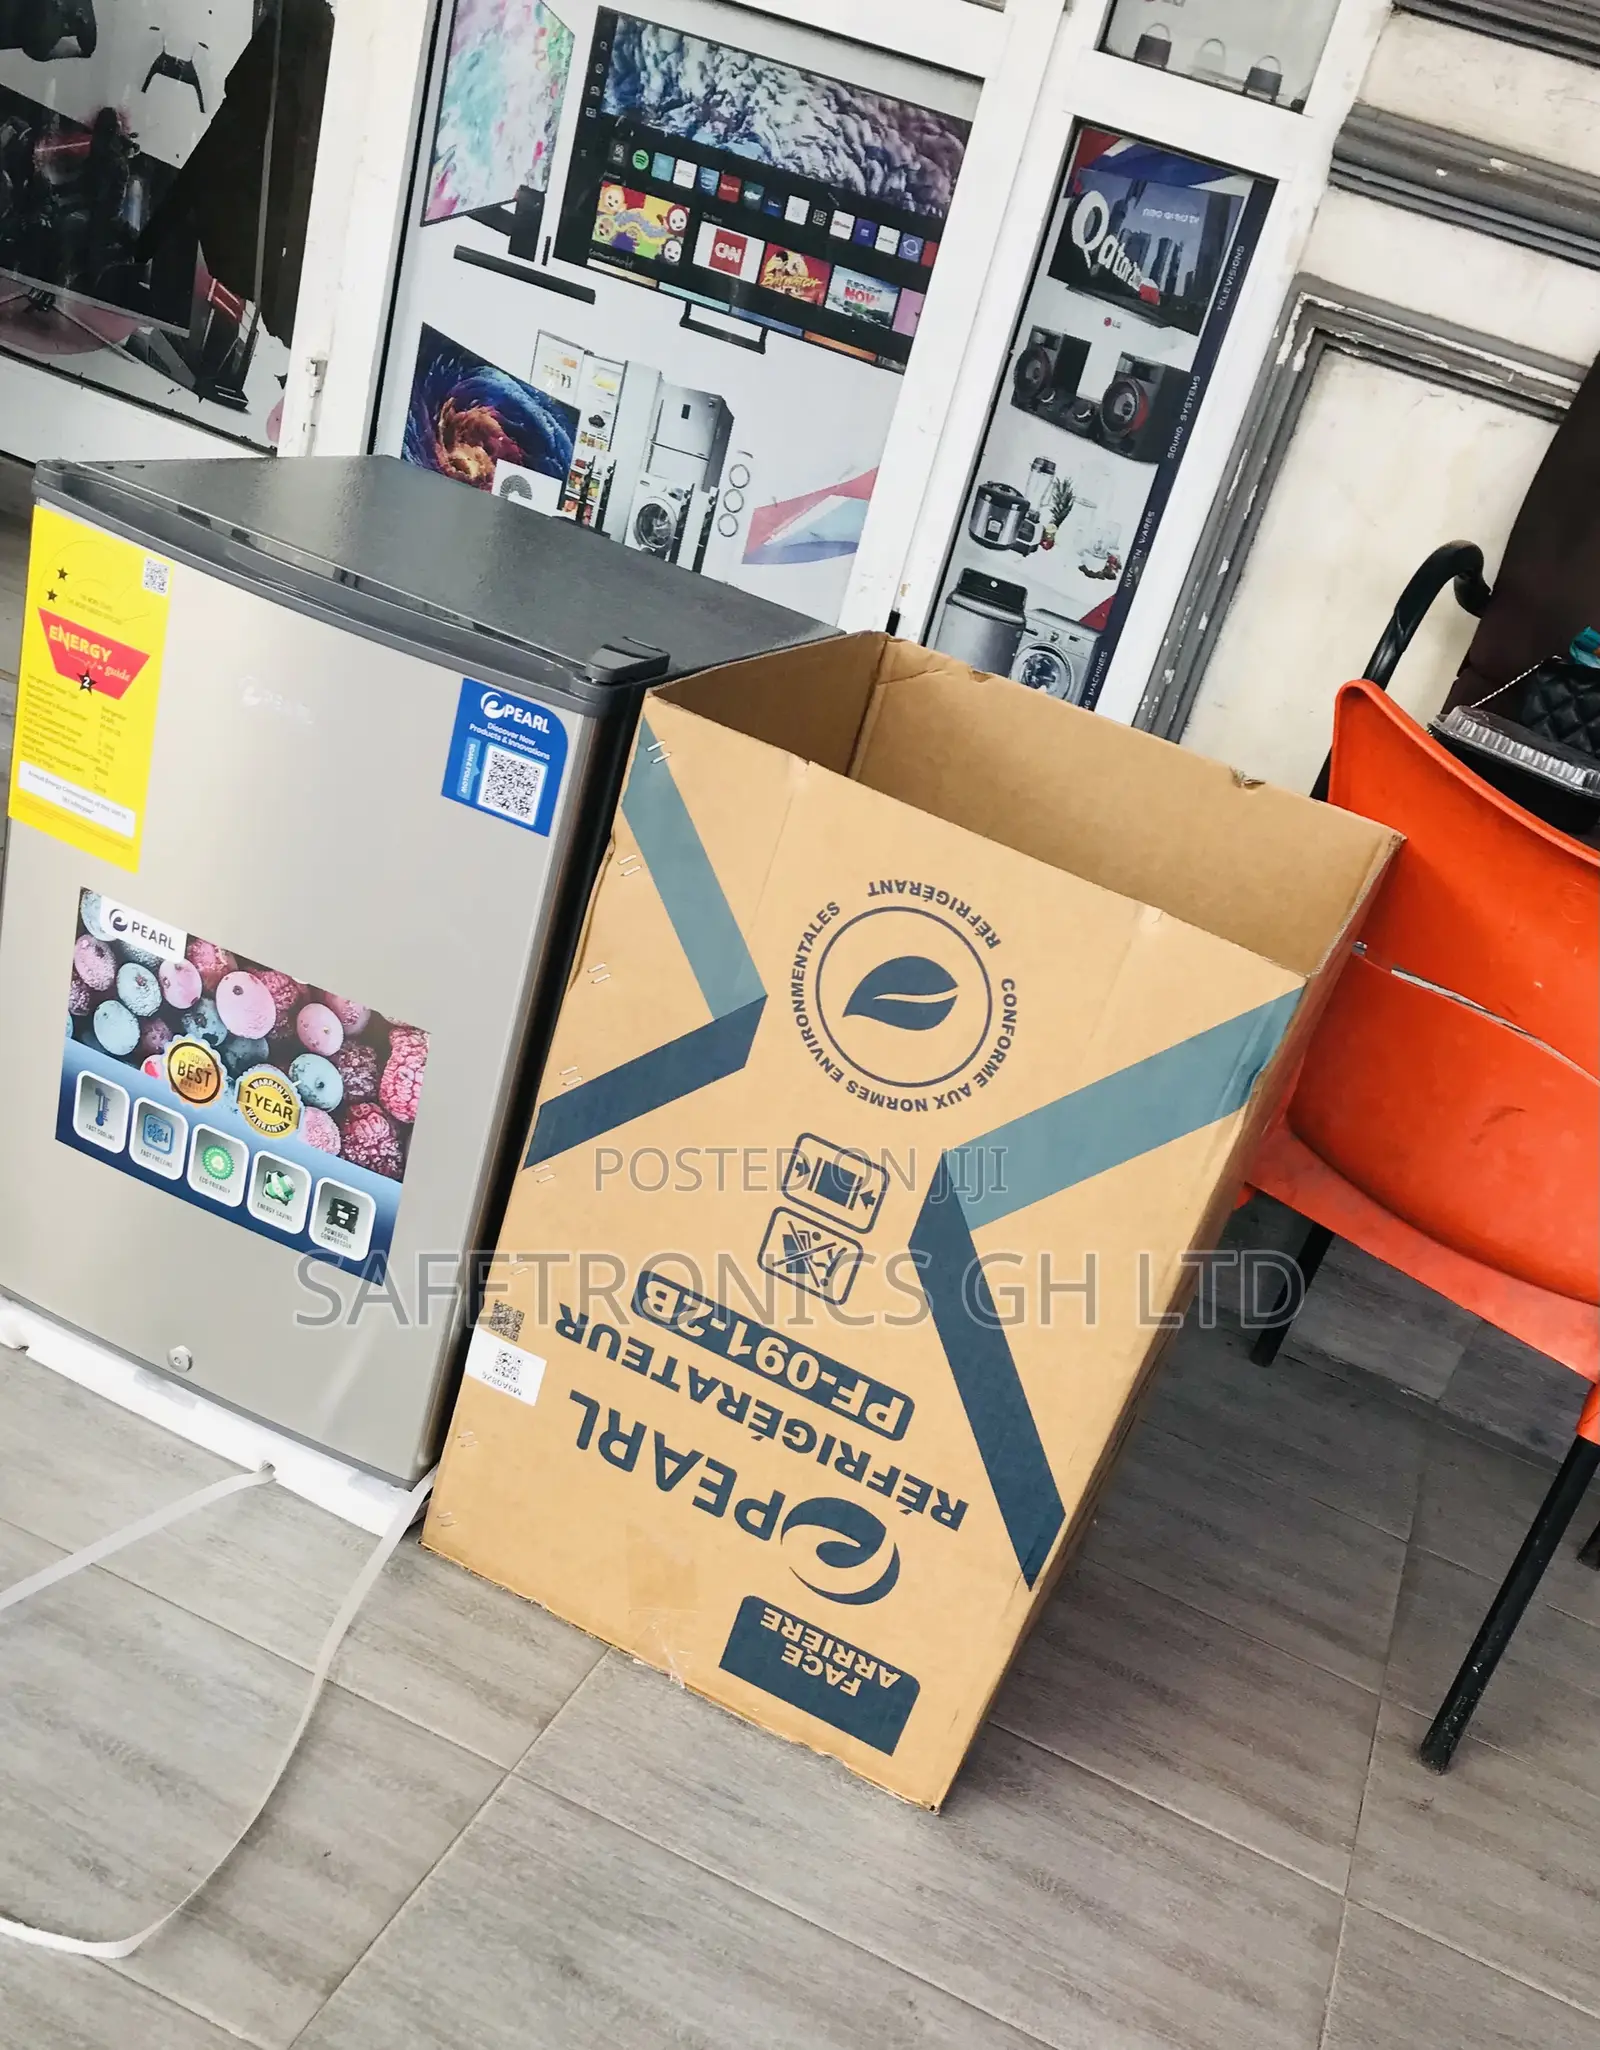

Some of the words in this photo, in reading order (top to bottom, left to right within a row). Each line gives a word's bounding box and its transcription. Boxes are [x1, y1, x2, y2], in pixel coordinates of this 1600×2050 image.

[714, 242, 742, 263] CNN
[1217, 245, 1245, 311] TELEVISIONS
[1167, 427, 1184, 459] SOUND
[1180, 375, 1201, 421] SYSTEMS
[1139, 510, 1155, 545] WARES
[48, 624, 113, 663] ENERGY
[83, 676, 90, 687] 2
[104, 665, 131, 682] guide
[1088, 651, 1108, 696] MACHINES
[487, 722, 519, 740] Discover
[503, 703, 550, 734] PEARL
[469, 723, 501, 742] Products
[501, 736, 508, 744] &
[508, 738, 551, 761] Innovations
[867, 879, 1002, 950] RÉFRIGÉRANT
[132, 920, 176, 951] PEARL
[791, 901, 845, 1083] ENVIRONMENTALES
[972, 977, 1018, 1088] CONFORME
[177, 1060, 212, 1087] BEST
[251, 1078, 291, 1104] WARRANTY
[245, 1090, 250, 1102] 1
[254, 1094, 293, 1121] YEAR
[845, 1080, 928, 1112] NORMES
[935, 1082, 972, 1110] AUX
[246, 1108, 287, 1133] WARRANTY
[641, 1279, 908, 1435] PF-091-2B
[554, 1302, 970, 1532] RÉFRIGÉRATEUR
[568, 1389, 788, 1543] PEARL
[760, 1606, 901, 1690] ARRIÈRE
[780, 1642, 863, 1698] FACE
